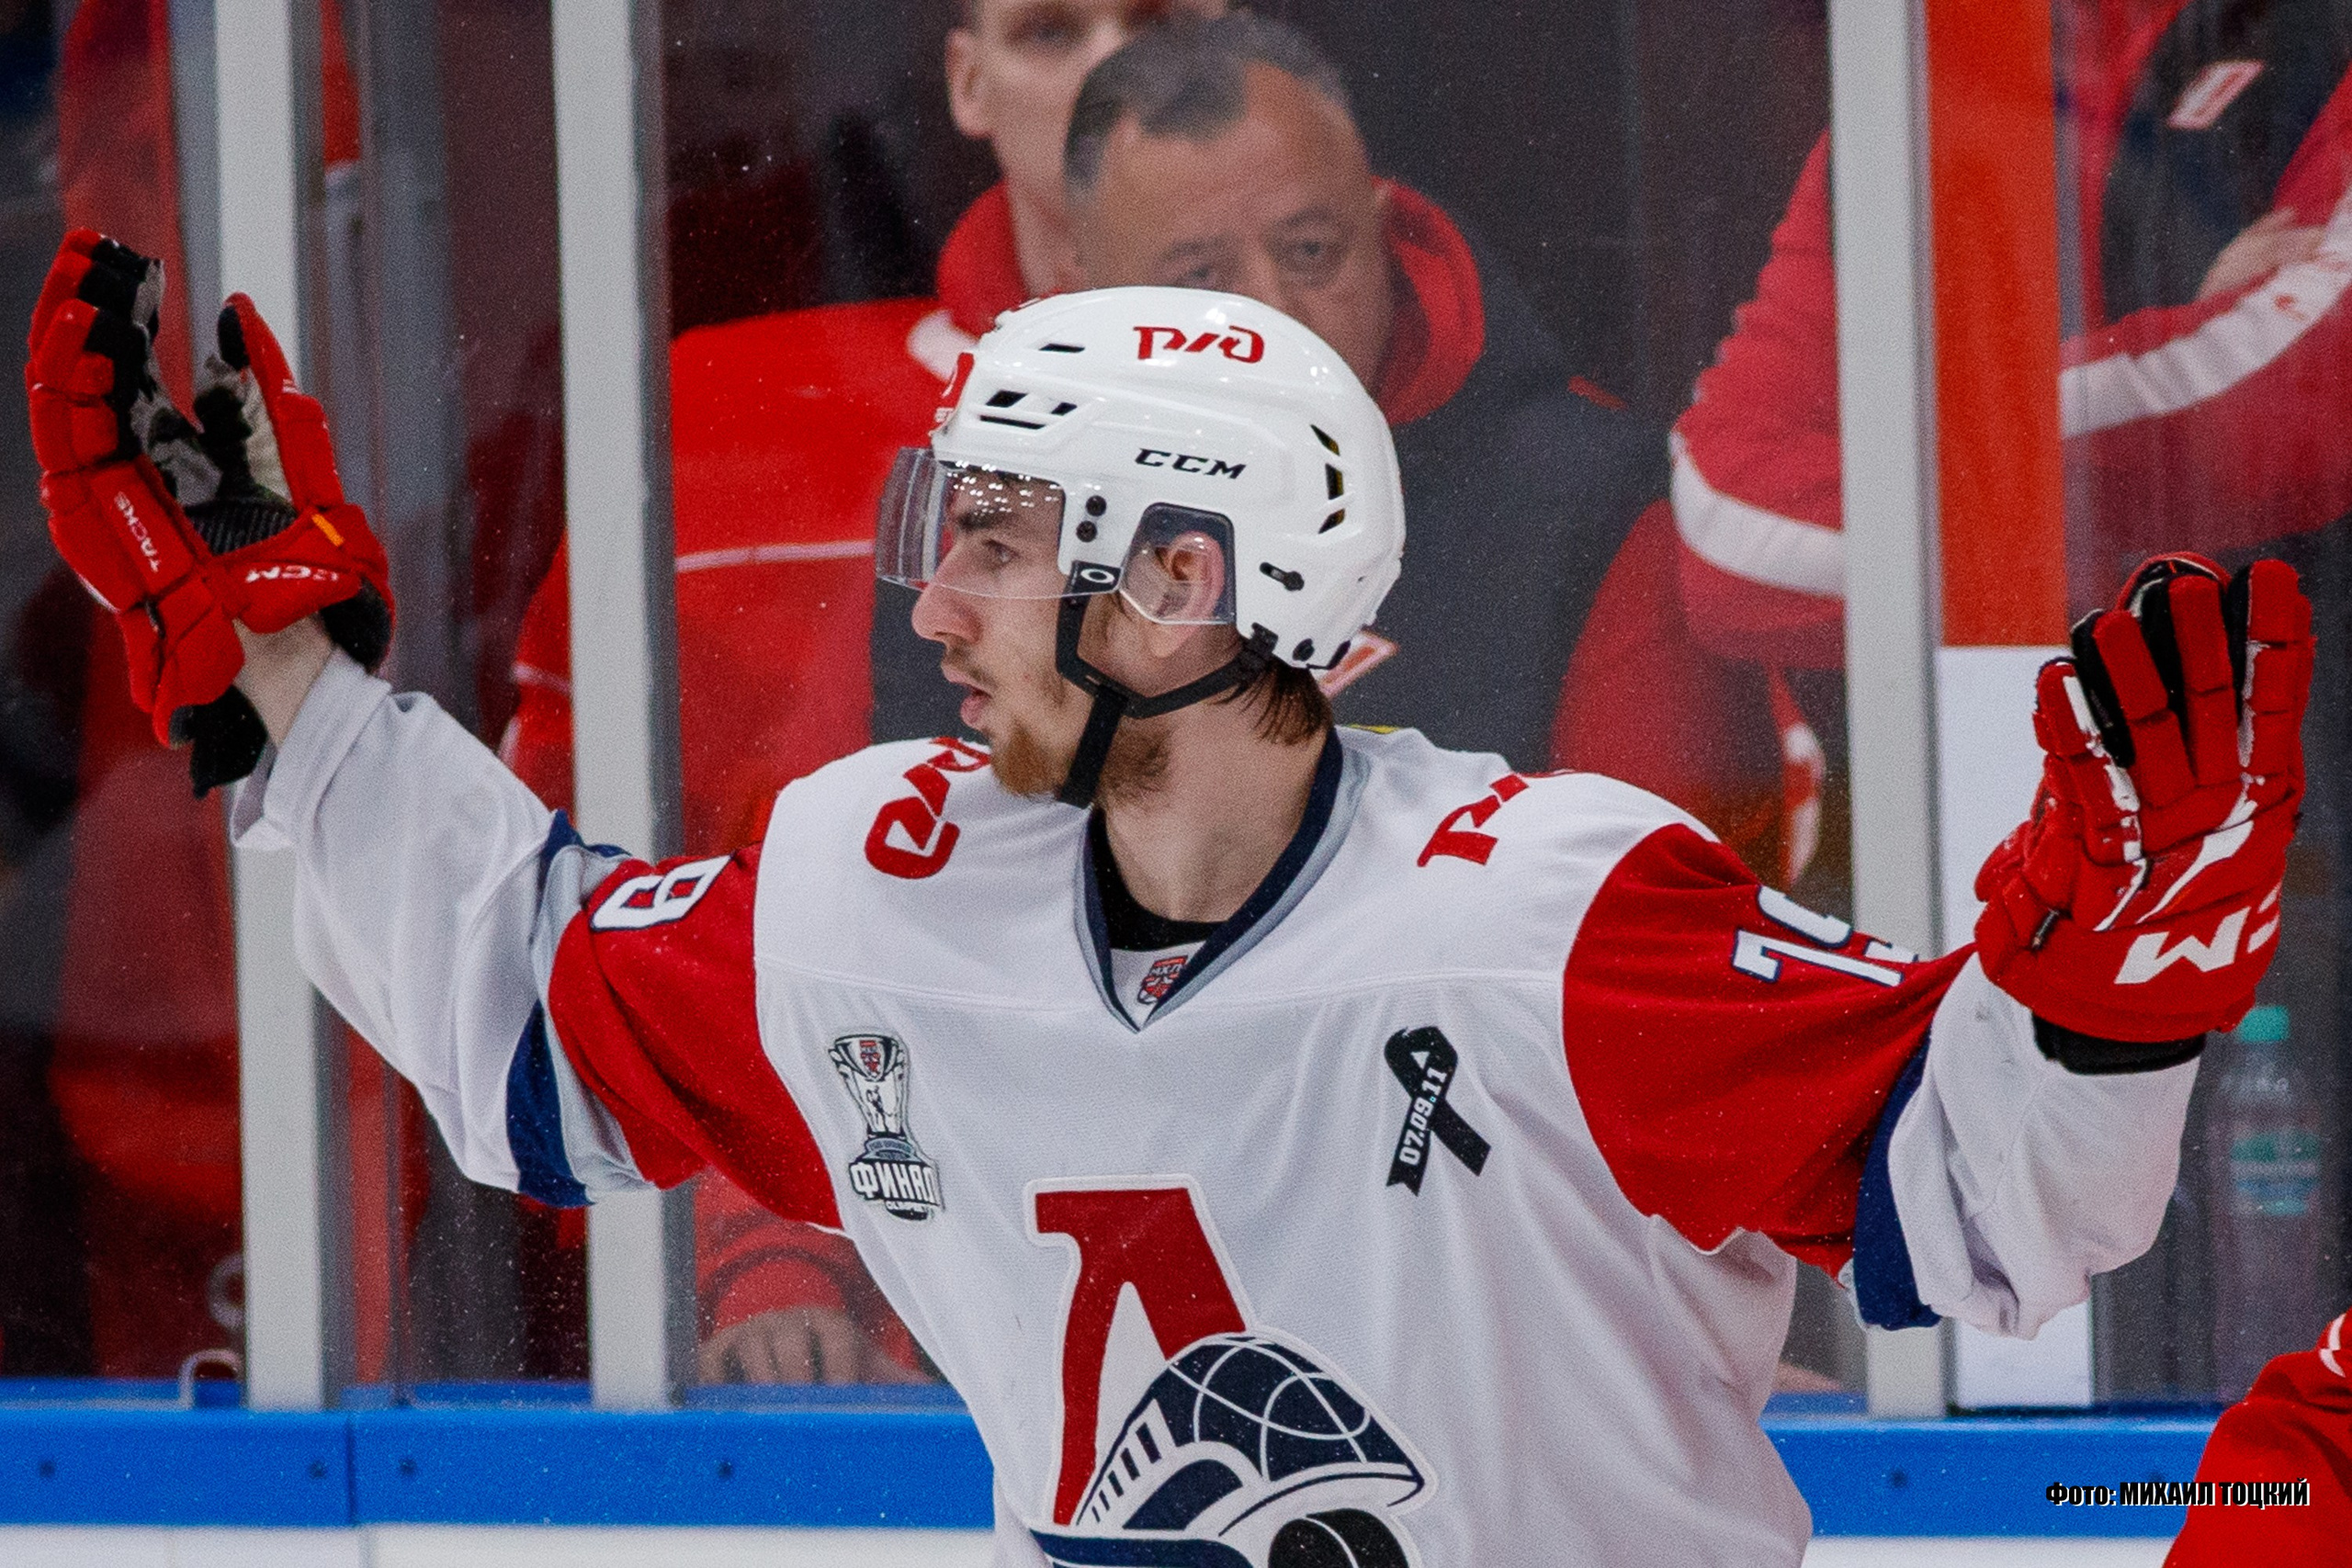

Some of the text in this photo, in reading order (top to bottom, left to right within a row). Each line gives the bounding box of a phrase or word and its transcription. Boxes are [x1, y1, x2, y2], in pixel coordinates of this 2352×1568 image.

[1136, 447, 1246, 479] CCM
[114, 491, 162, 572] TACKS
[1399, 1067, 1448, 1166] 07.09.11
[850, 1162, 936, 1202] ФИНАЛ
